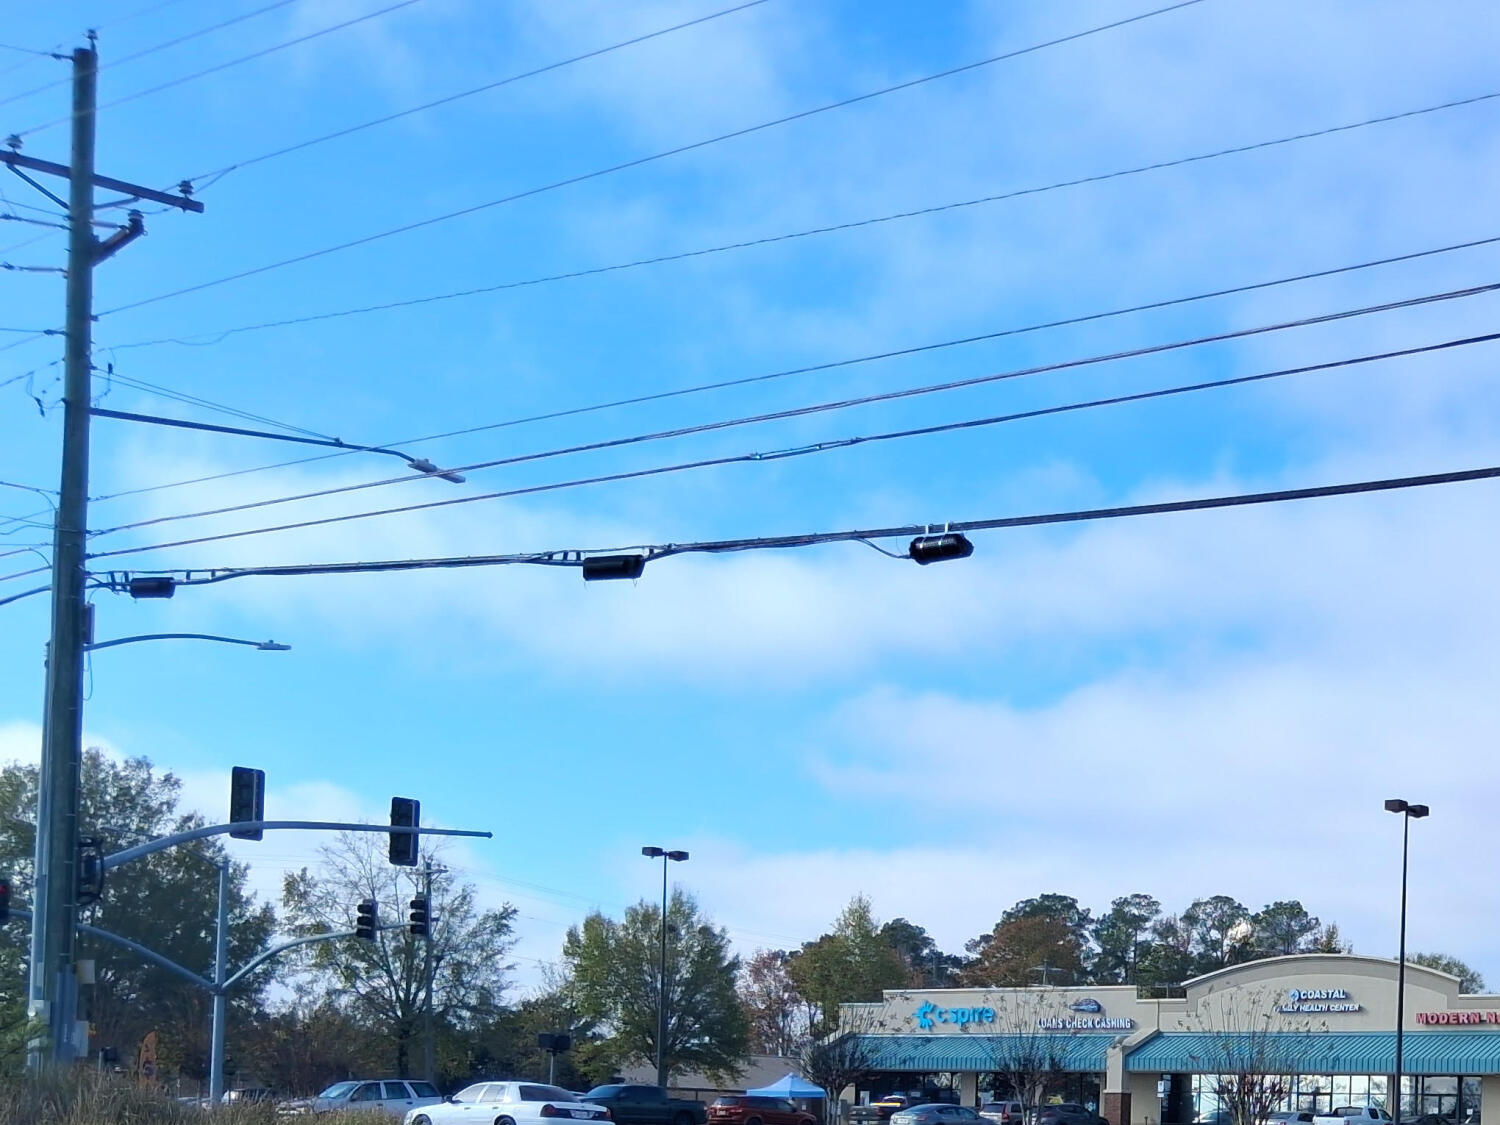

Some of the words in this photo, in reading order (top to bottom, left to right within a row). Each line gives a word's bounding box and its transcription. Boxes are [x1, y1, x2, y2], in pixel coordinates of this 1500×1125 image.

[1301, 989, 1346, 1000] COASTAL
[1299, 1003, 1328, 1012] HEALTH
[1329, 1003, 1360, 1012] CENTER
[1037, 1017, 1063, 1028] LOANS
[1066, 1017, 1093, 1028] CHECK
[1095, 1016, 1131, 1028] CASHING
[1416, 1012, 1481, 1025] MODERN
